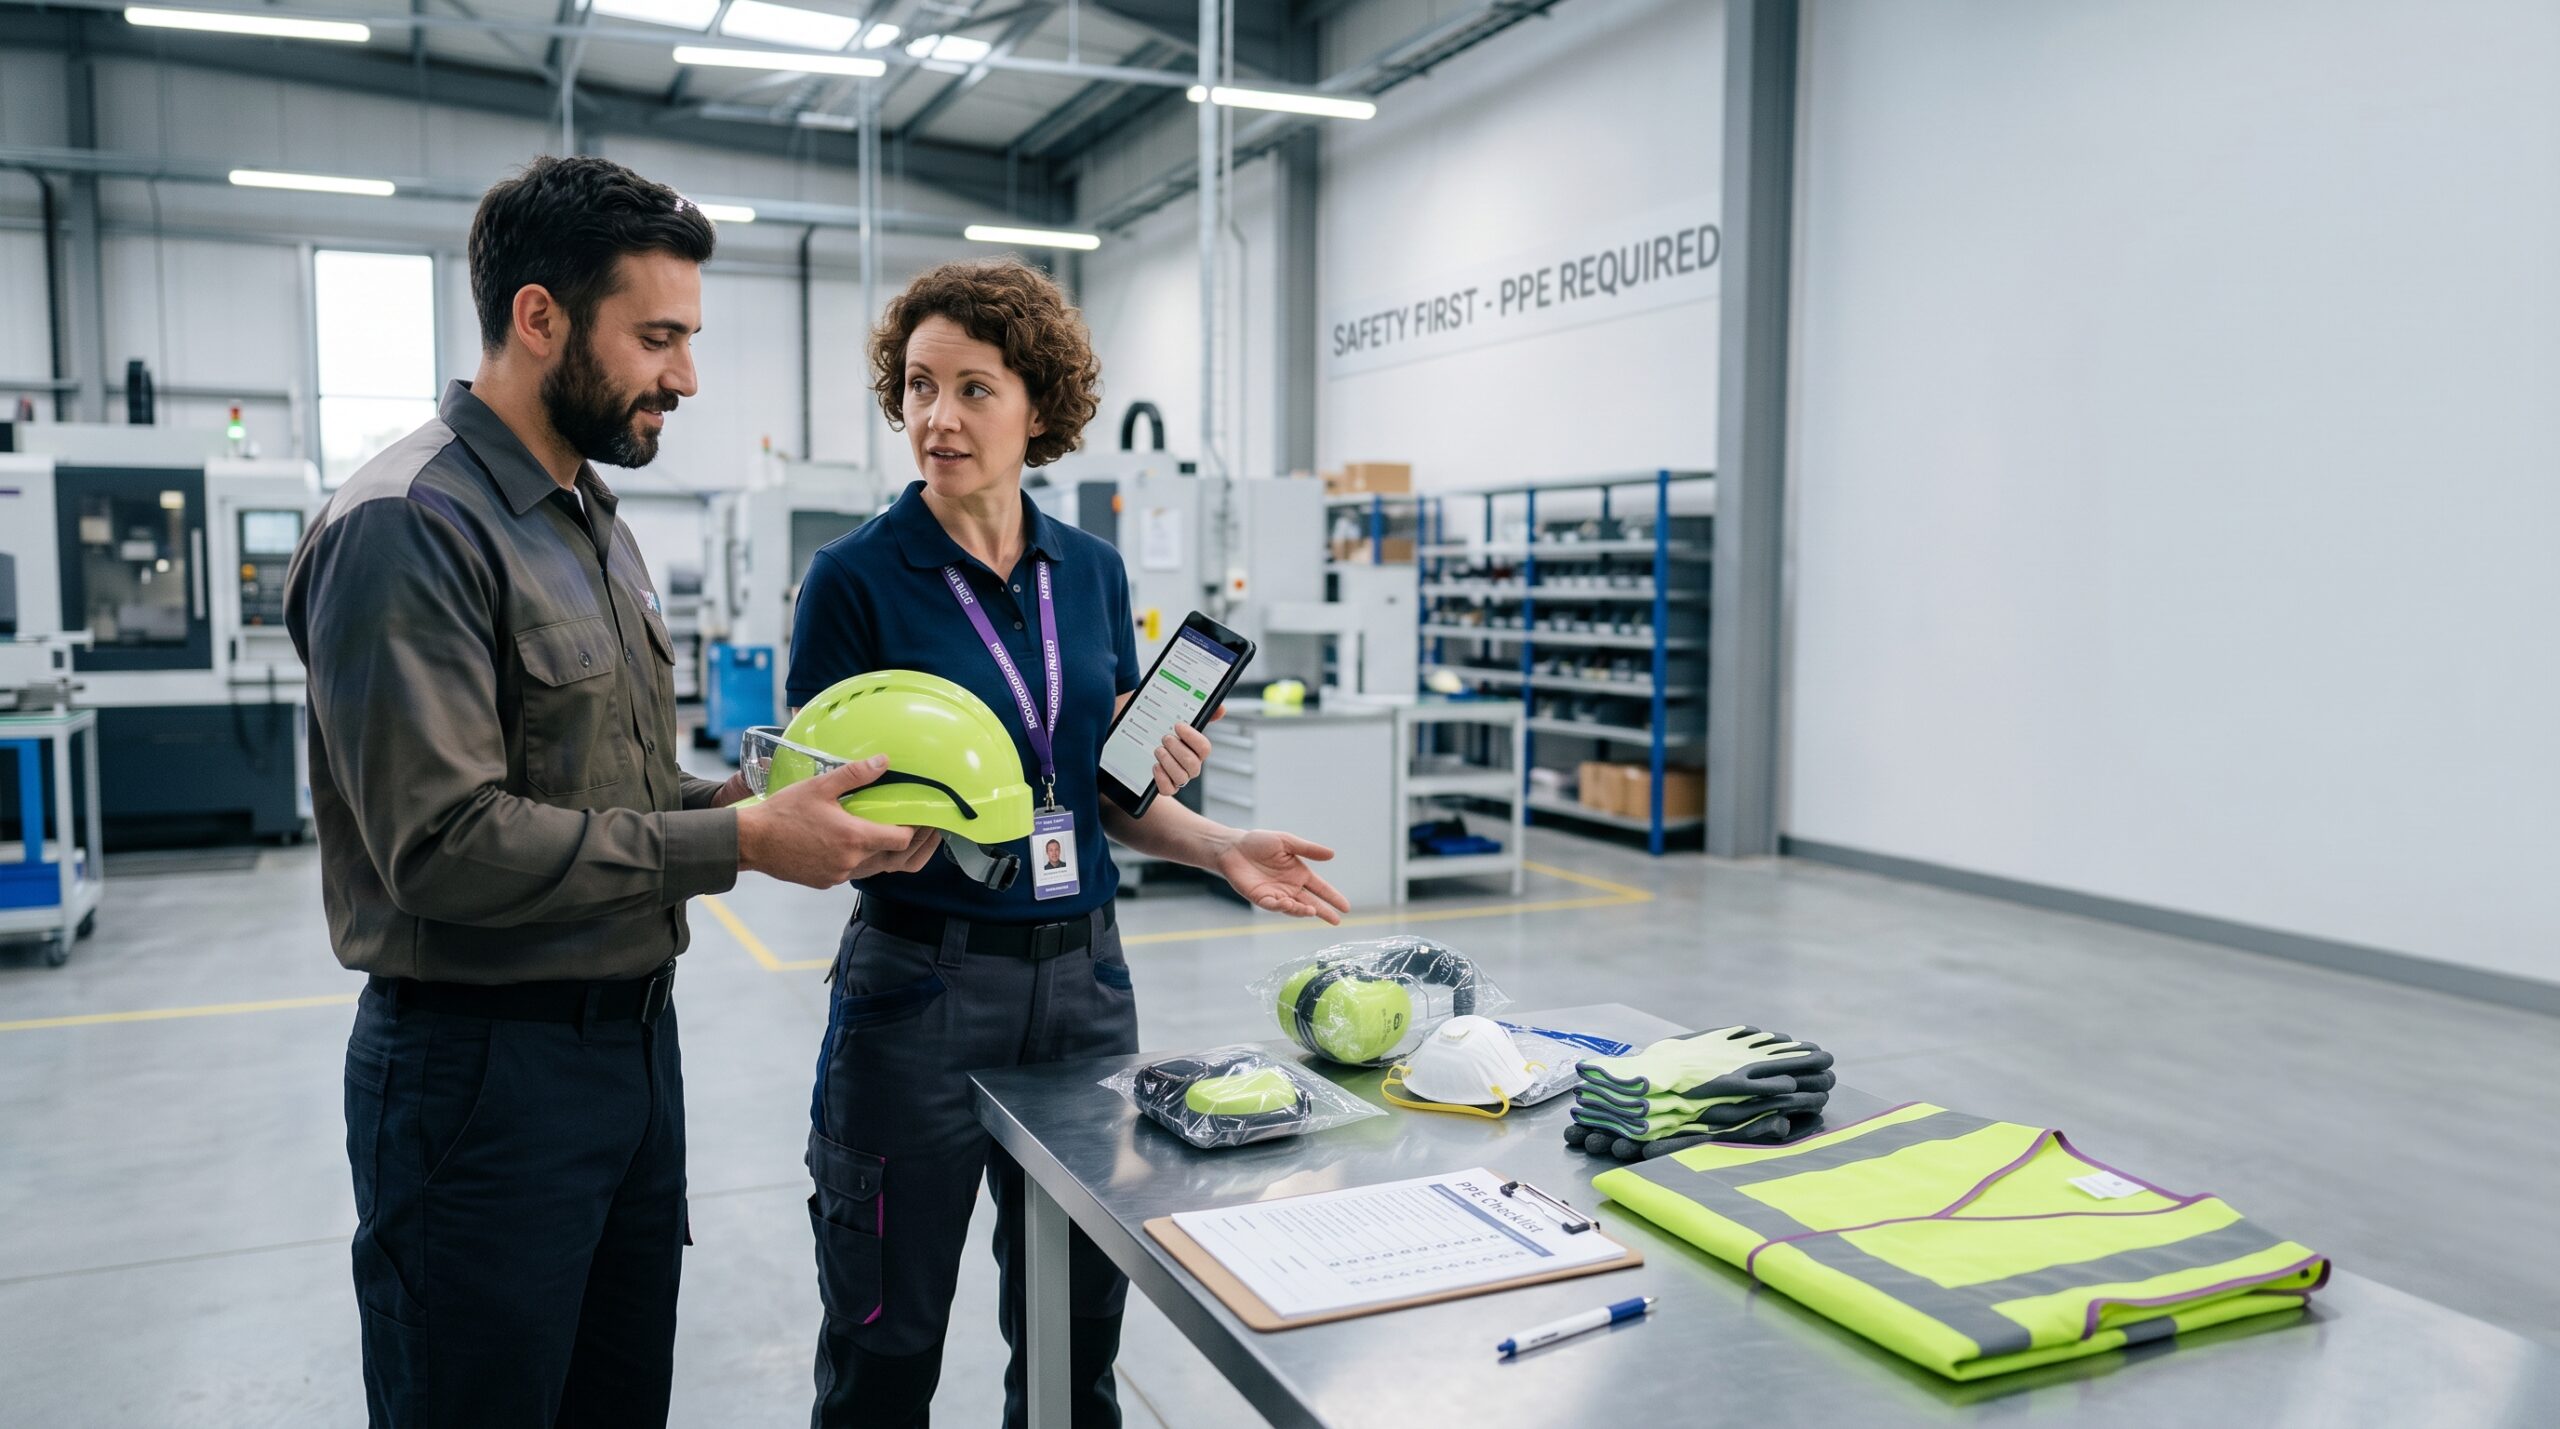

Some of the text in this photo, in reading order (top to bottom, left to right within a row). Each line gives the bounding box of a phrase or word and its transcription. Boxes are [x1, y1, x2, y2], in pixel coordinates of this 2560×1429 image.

[1333, 306, 1408, 357] SAFETY
[1414, 287, 1478, 337] FIRST
[1500, 267, 1552, 317] PPE
[1560, 223, 1721, 302] REQUIRED
[1456, 1181, 1487, 1198] PPE
[1481, 1197, 1544, 1233] Checklist
